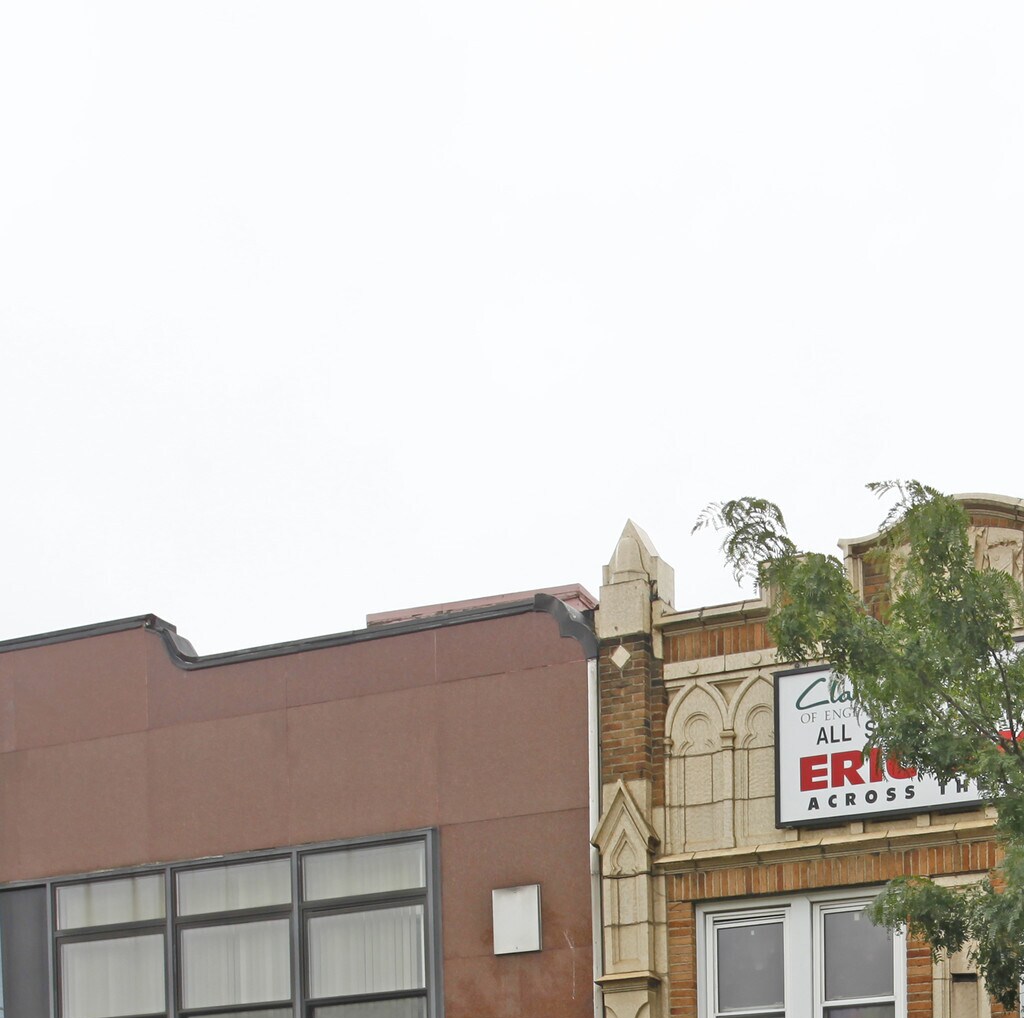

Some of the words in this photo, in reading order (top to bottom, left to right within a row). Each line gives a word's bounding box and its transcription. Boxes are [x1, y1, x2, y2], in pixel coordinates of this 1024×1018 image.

[801, 712, 817, 724] OF
[816, 724, 852, 745] ALL
[808, 785, 915, 811] ACROSS
